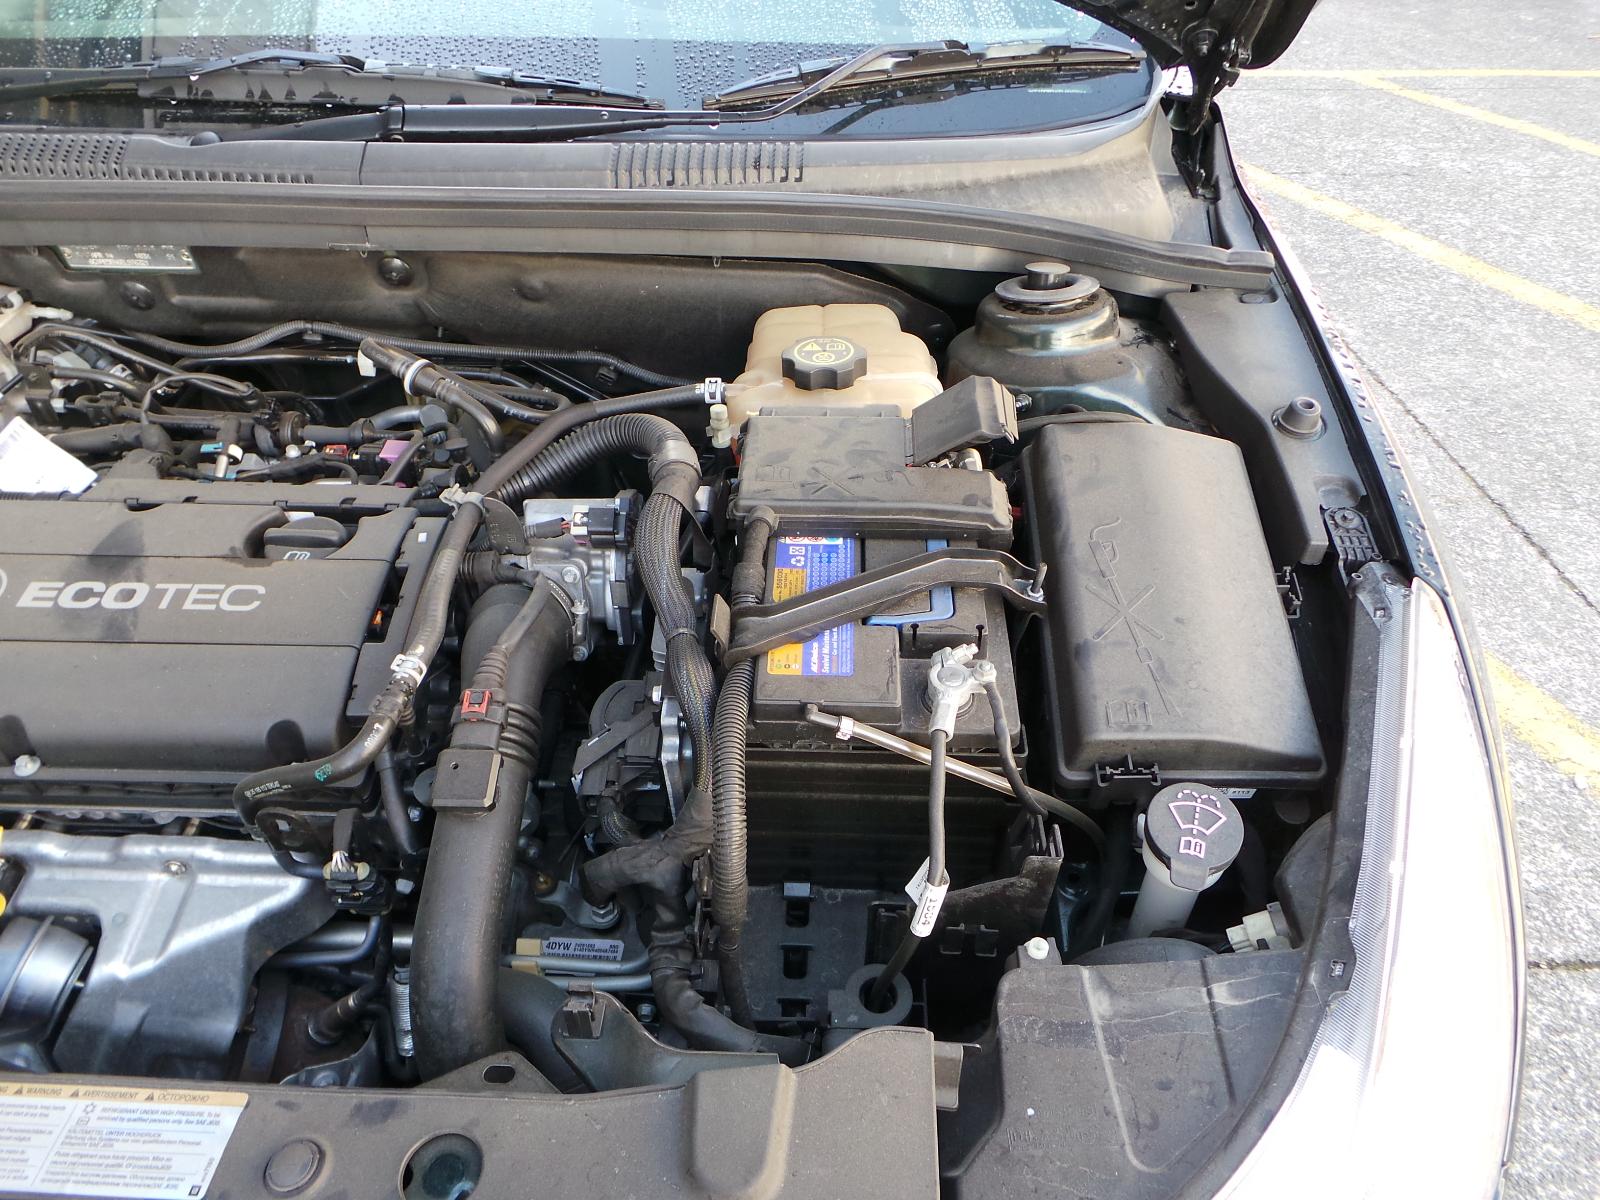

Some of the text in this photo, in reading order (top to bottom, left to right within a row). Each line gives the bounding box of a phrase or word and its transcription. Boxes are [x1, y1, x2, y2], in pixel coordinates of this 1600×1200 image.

[15, 581, 267, 612] ECOTEC
[545, 941, 572, 951] 4DYW
[26, 1086, 63, 1096] WARNUNG
[83, 1089, 139, 1099] AVERTISSEMENT
